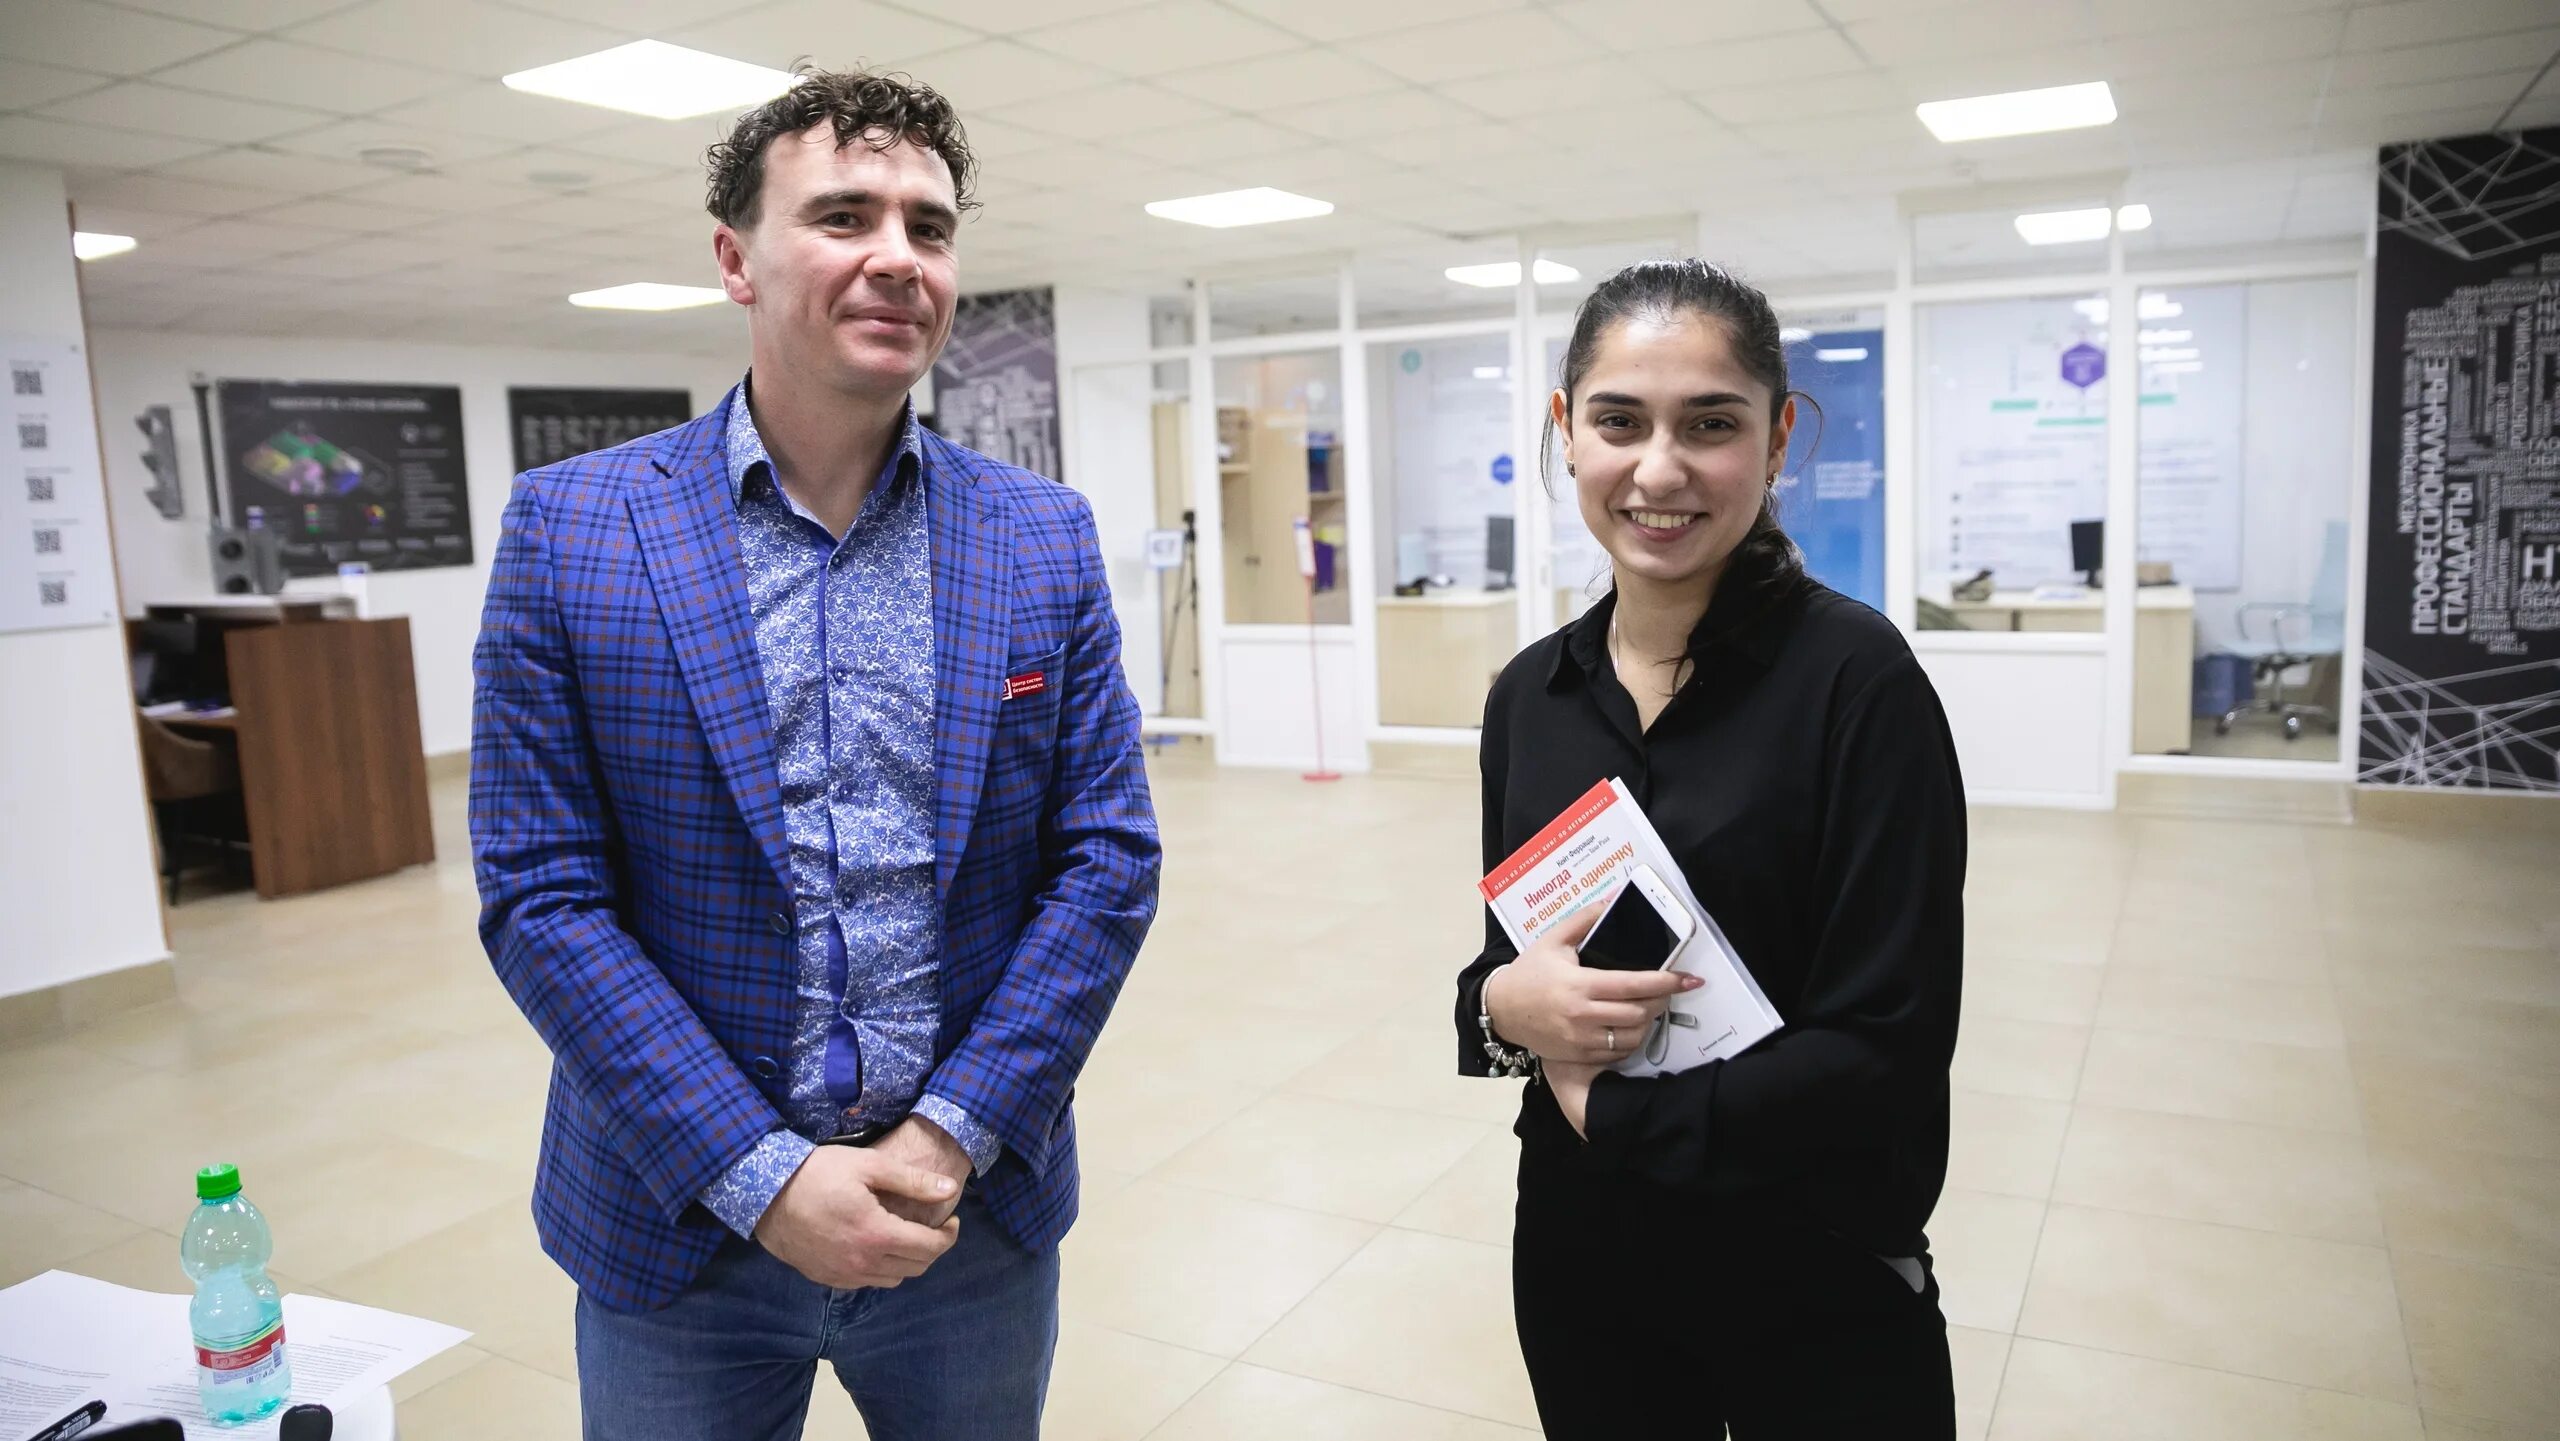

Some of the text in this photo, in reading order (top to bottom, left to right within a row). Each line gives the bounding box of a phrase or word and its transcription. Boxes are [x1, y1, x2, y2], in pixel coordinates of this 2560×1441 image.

[2397, 408, 2419, 534] МЕХАТРОНИКА
[2411, 357, 2449, 635] ПРОФЕССИОНАЛЬНЫЕ
[2441, 481, 2475, 635] СТАНДАРТЫ
[2522, 544, 2560, 580] Н
[1494, 877, 1510, 891] ОДНА
[1518, 851, 1541, 870] ЛУЧШИХ
[1542, 837, 1557, 851] КНИГ
[1558, 830, 1567, 838] ПО
[1567, 796, 1608, 831] НЕТВОРКИНГУ
[1522, 916, 1538, 933] не
[1537, 891, 1572, 921] ешьте
[1571, 884, 1581, 896] в
[1580, 841, 1634, 888] одиночку
[1524, 869, 1572, 909] Никогда
